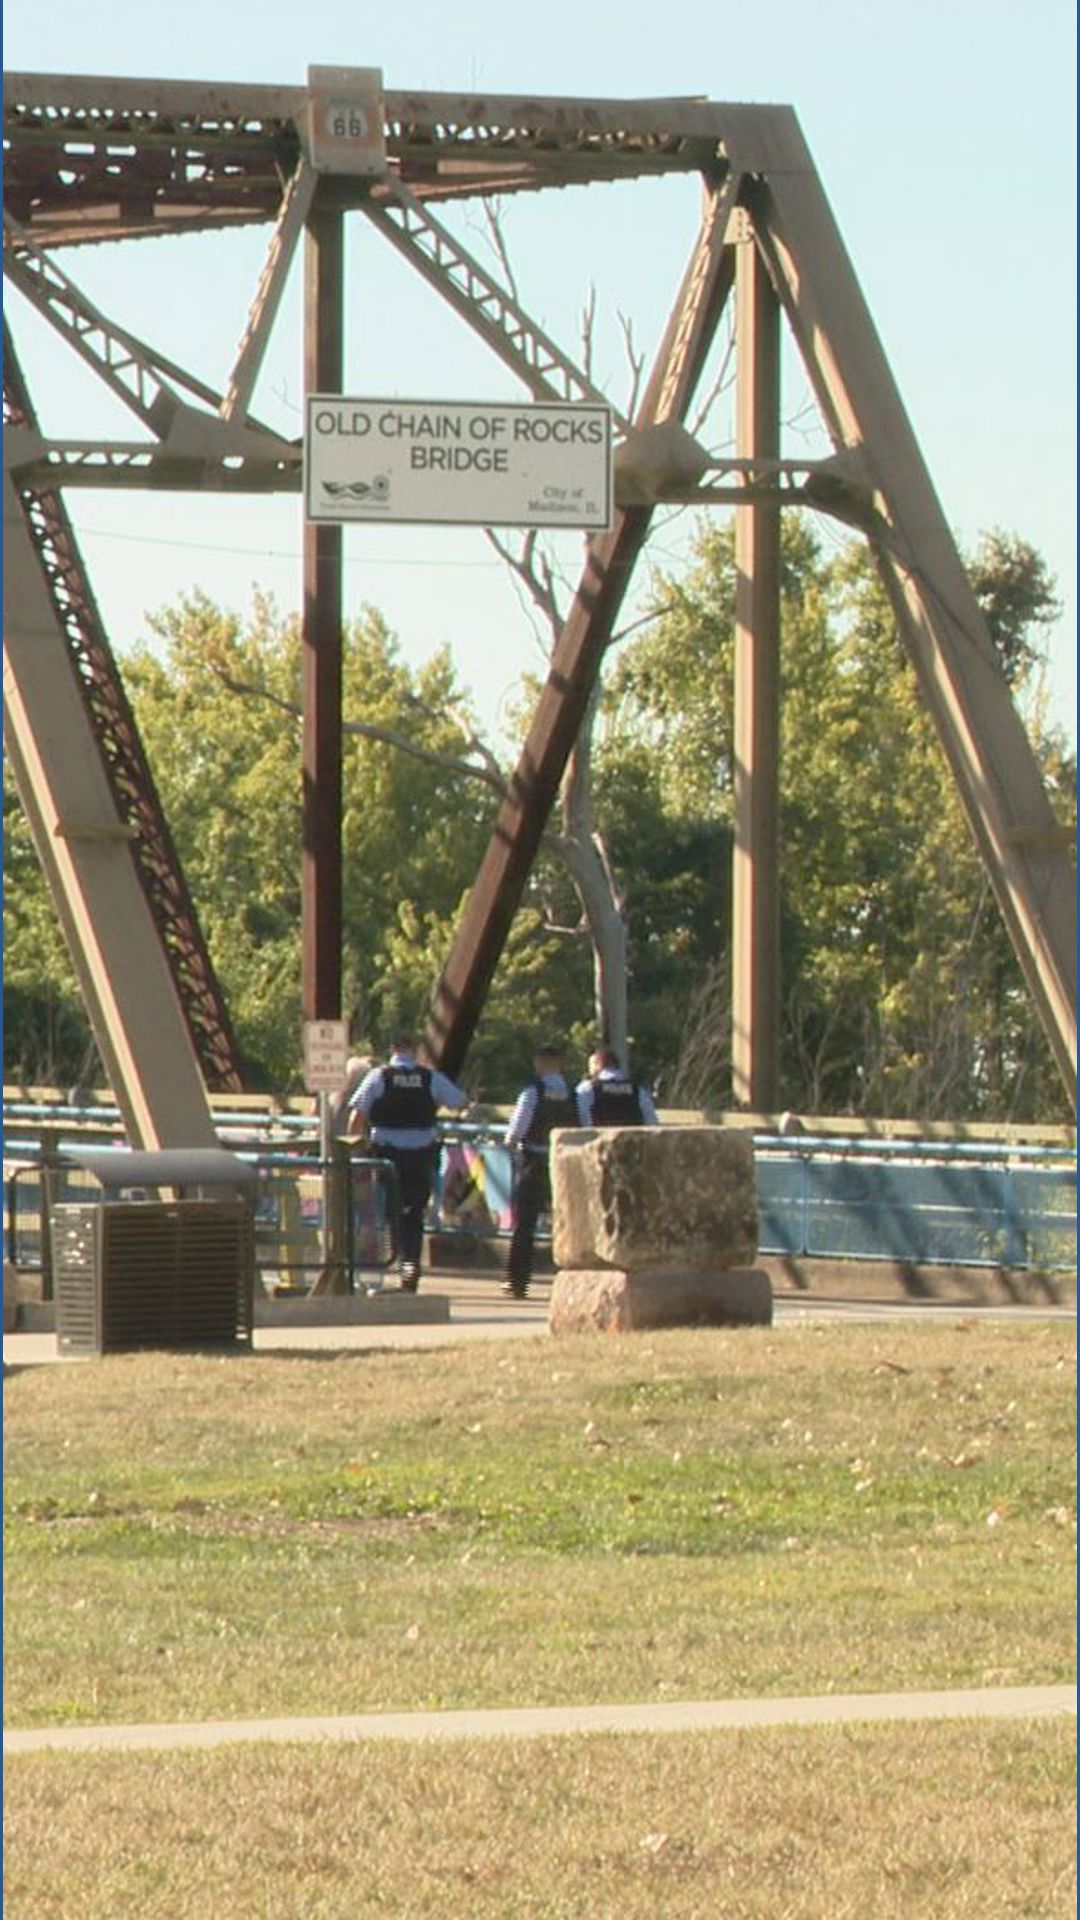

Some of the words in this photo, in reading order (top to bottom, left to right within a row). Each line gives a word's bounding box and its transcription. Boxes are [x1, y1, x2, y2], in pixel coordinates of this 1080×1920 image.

[333, 118, 361, 137] 66
[315, 411, 371, 435] OLD
[378, 413, 461, 439] CHAIN
[469, 416, 506, 440] OF
[513, 417, 603, 444] ROCKS
[410, 446, 508, 472] BRIDGE
[543, 486, 567, 500] City
